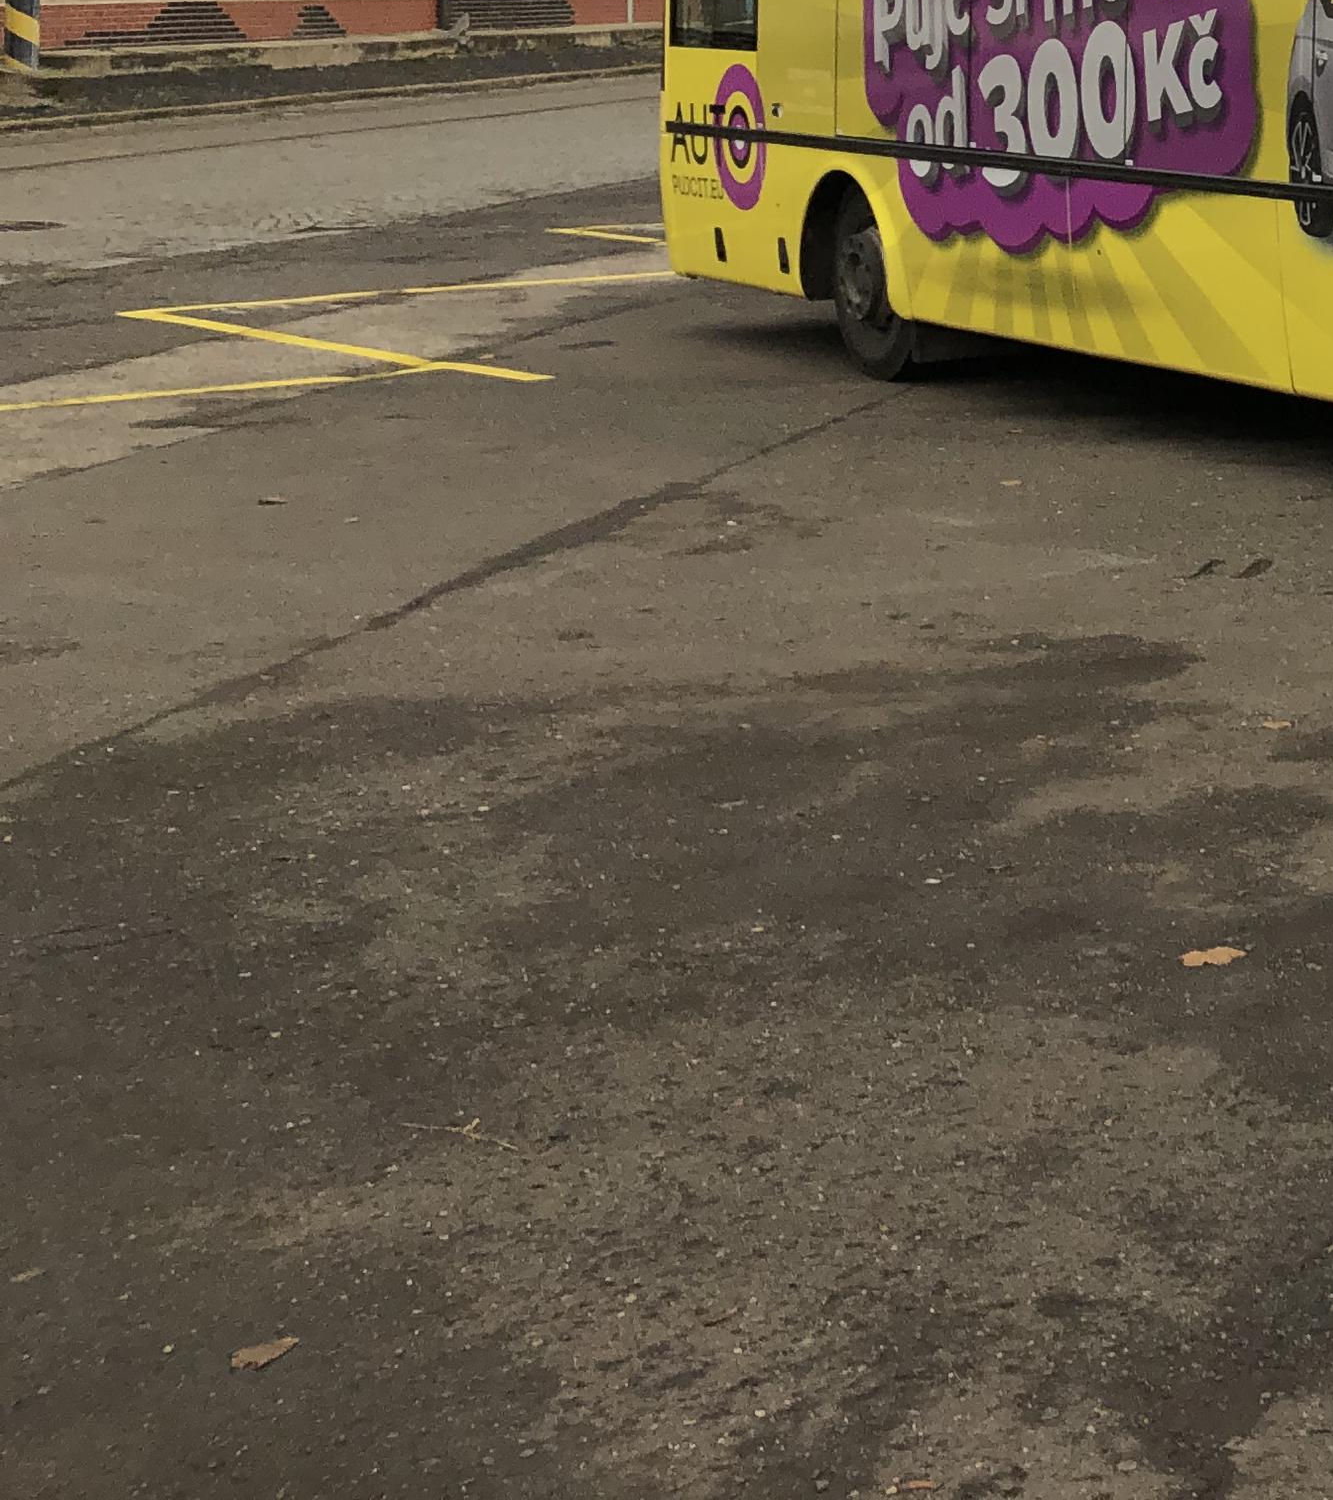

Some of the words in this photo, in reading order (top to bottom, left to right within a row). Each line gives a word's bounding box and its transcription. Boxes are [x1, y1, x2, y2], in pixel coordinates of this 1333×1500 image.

[906, 65, 970, 178] od
[977, 20, 1137, 188] 300
[1142, 8, 1223, 122] Kč
